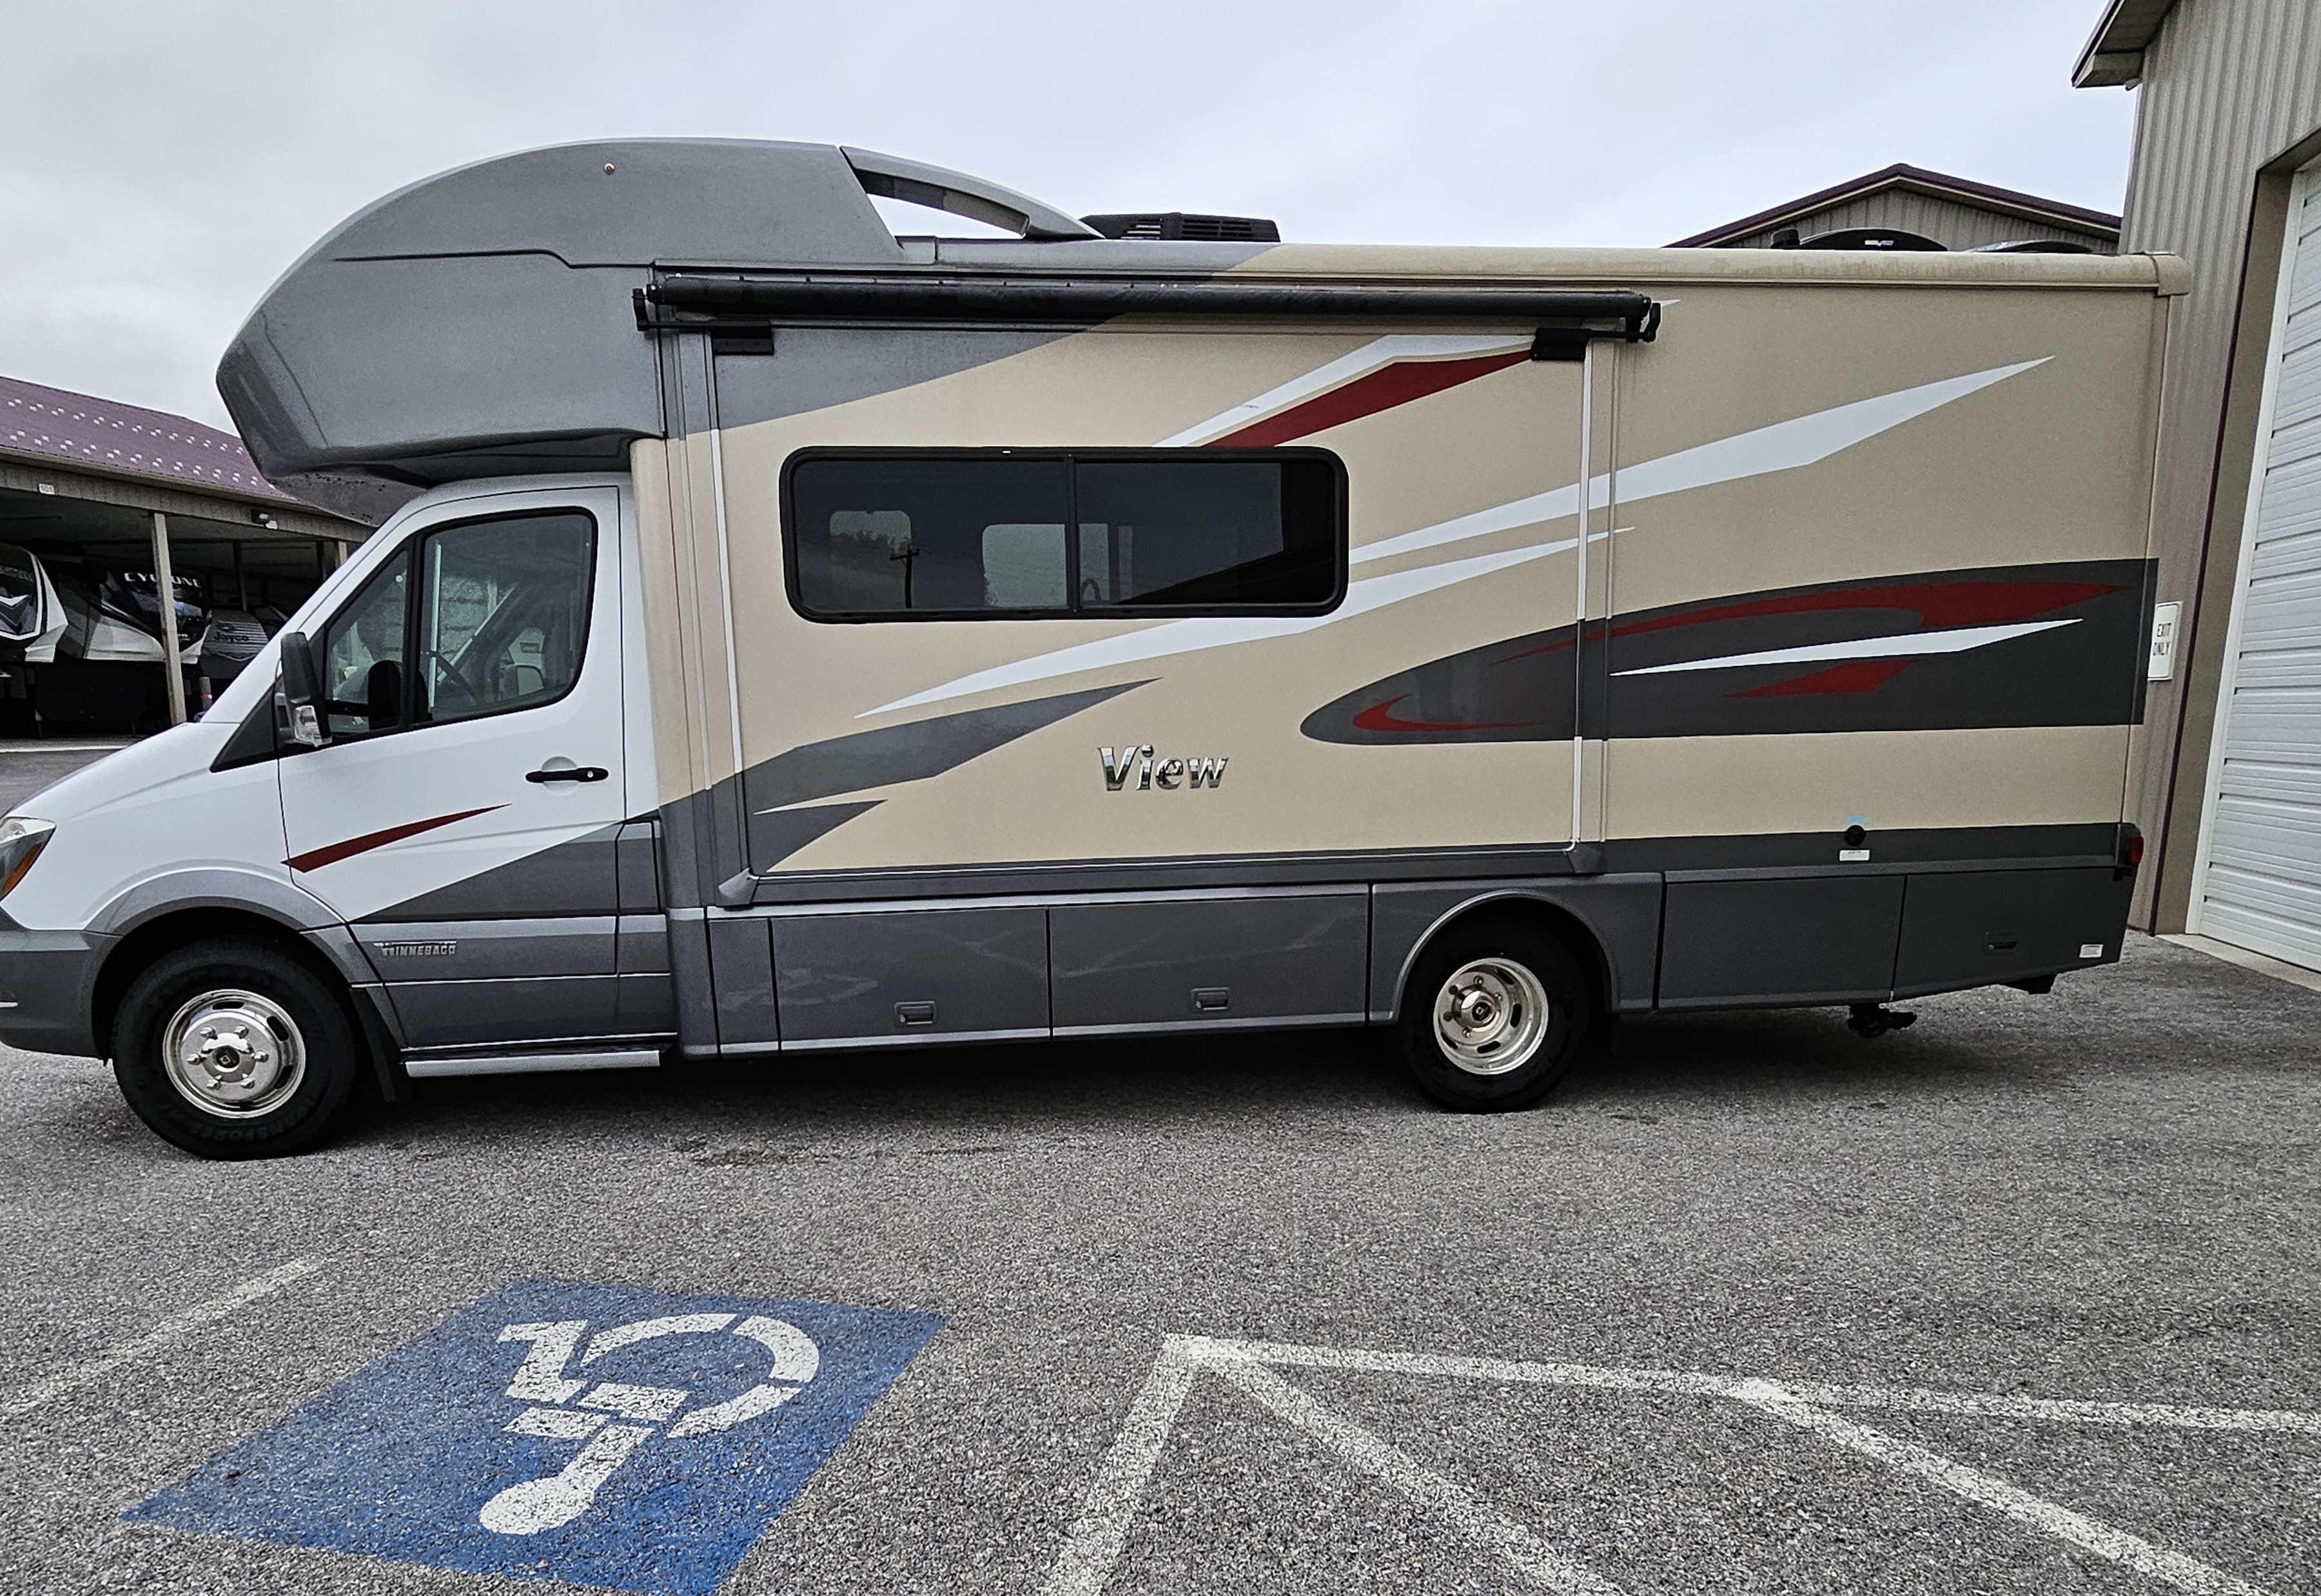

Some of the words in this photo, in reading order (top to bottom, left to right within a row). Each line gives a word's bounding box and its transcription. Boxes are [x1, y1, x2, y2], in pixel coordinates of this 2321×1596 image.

[124, 572, 201, 588] CYCONE
[2157, 623, 2171, 637] EXIT
[213, 632, 249, 643] Jayco
[2153, 641, 2171, 656] ONLY
[1097, 744, 1229, 791] View
[382, 944, 456, 957] WINNEBAGO
